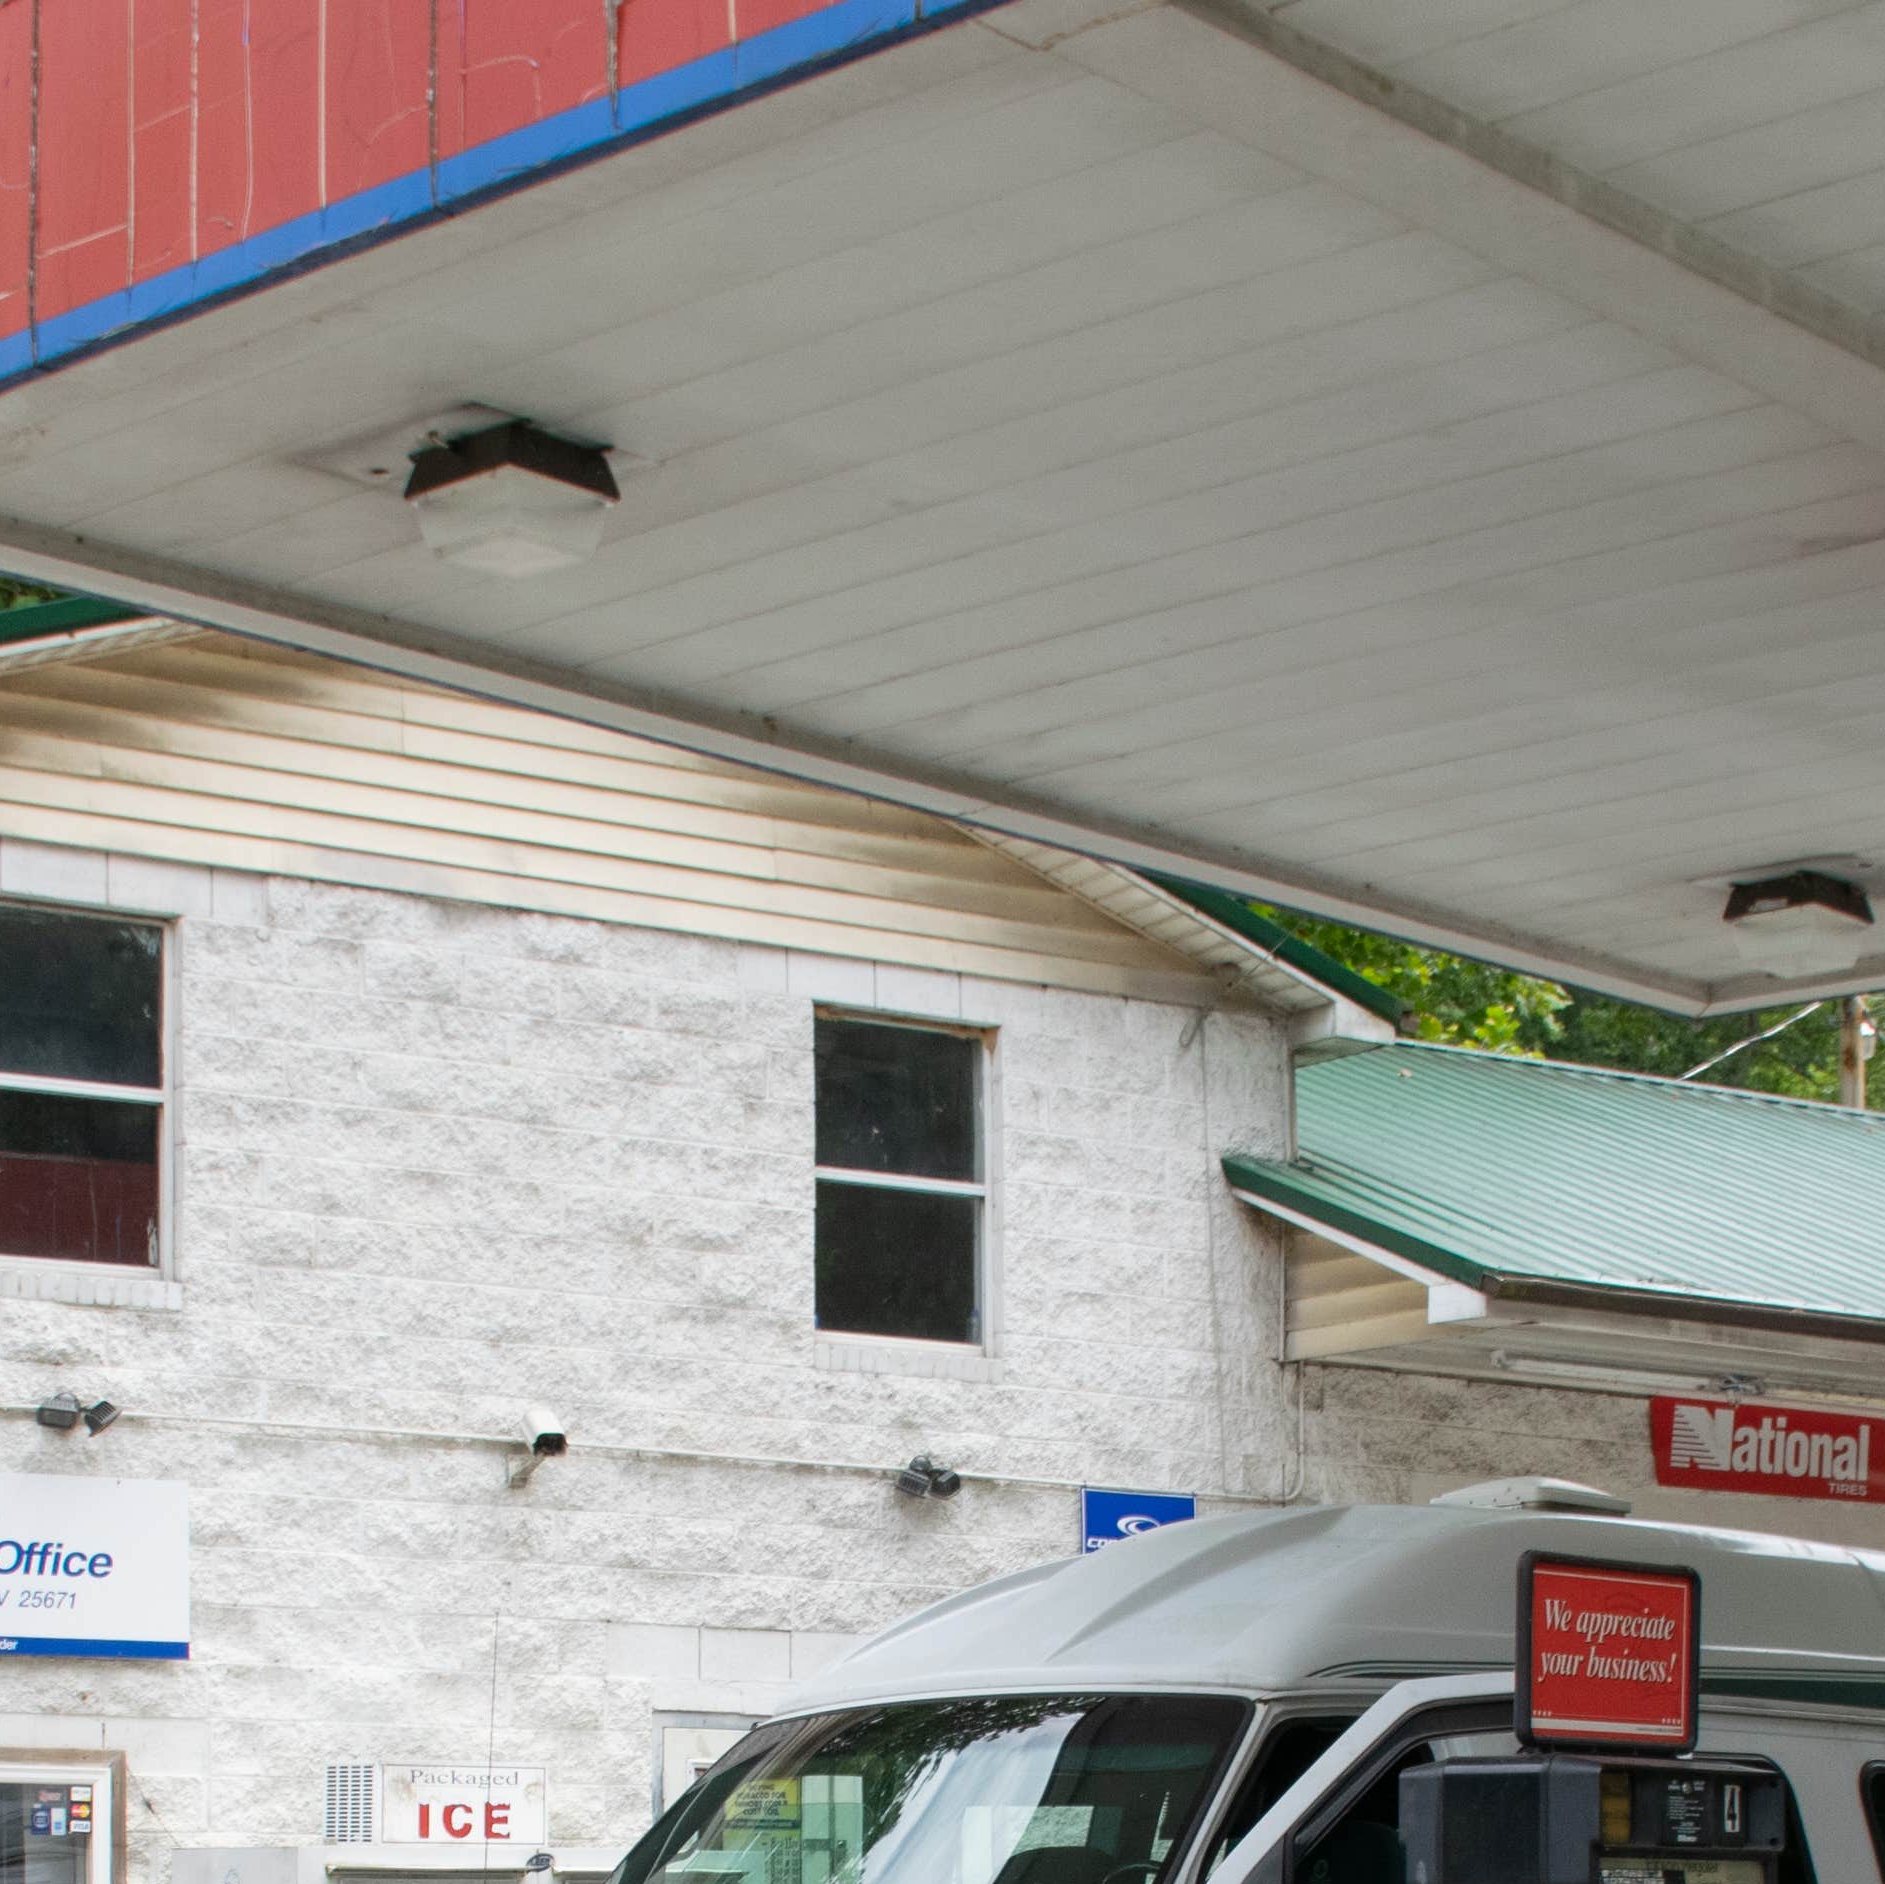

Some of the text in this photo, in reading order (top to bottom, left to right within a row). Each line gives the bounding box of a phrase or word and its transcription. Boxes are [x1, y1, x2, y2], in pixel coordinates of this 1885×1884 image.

[1670, 1404, 1871, 1481] National
[1828, 1482, 1868, 1497] TIRES
[18, 1590, 76, 1609] 25671
[1545, 1598, 1676, 1643] We appreciate
[1538, 1646, 1677, 1683] your business!
[409, 1768, 519, 1790] Packaged
[418, 1801, 511, 1840] ICE
